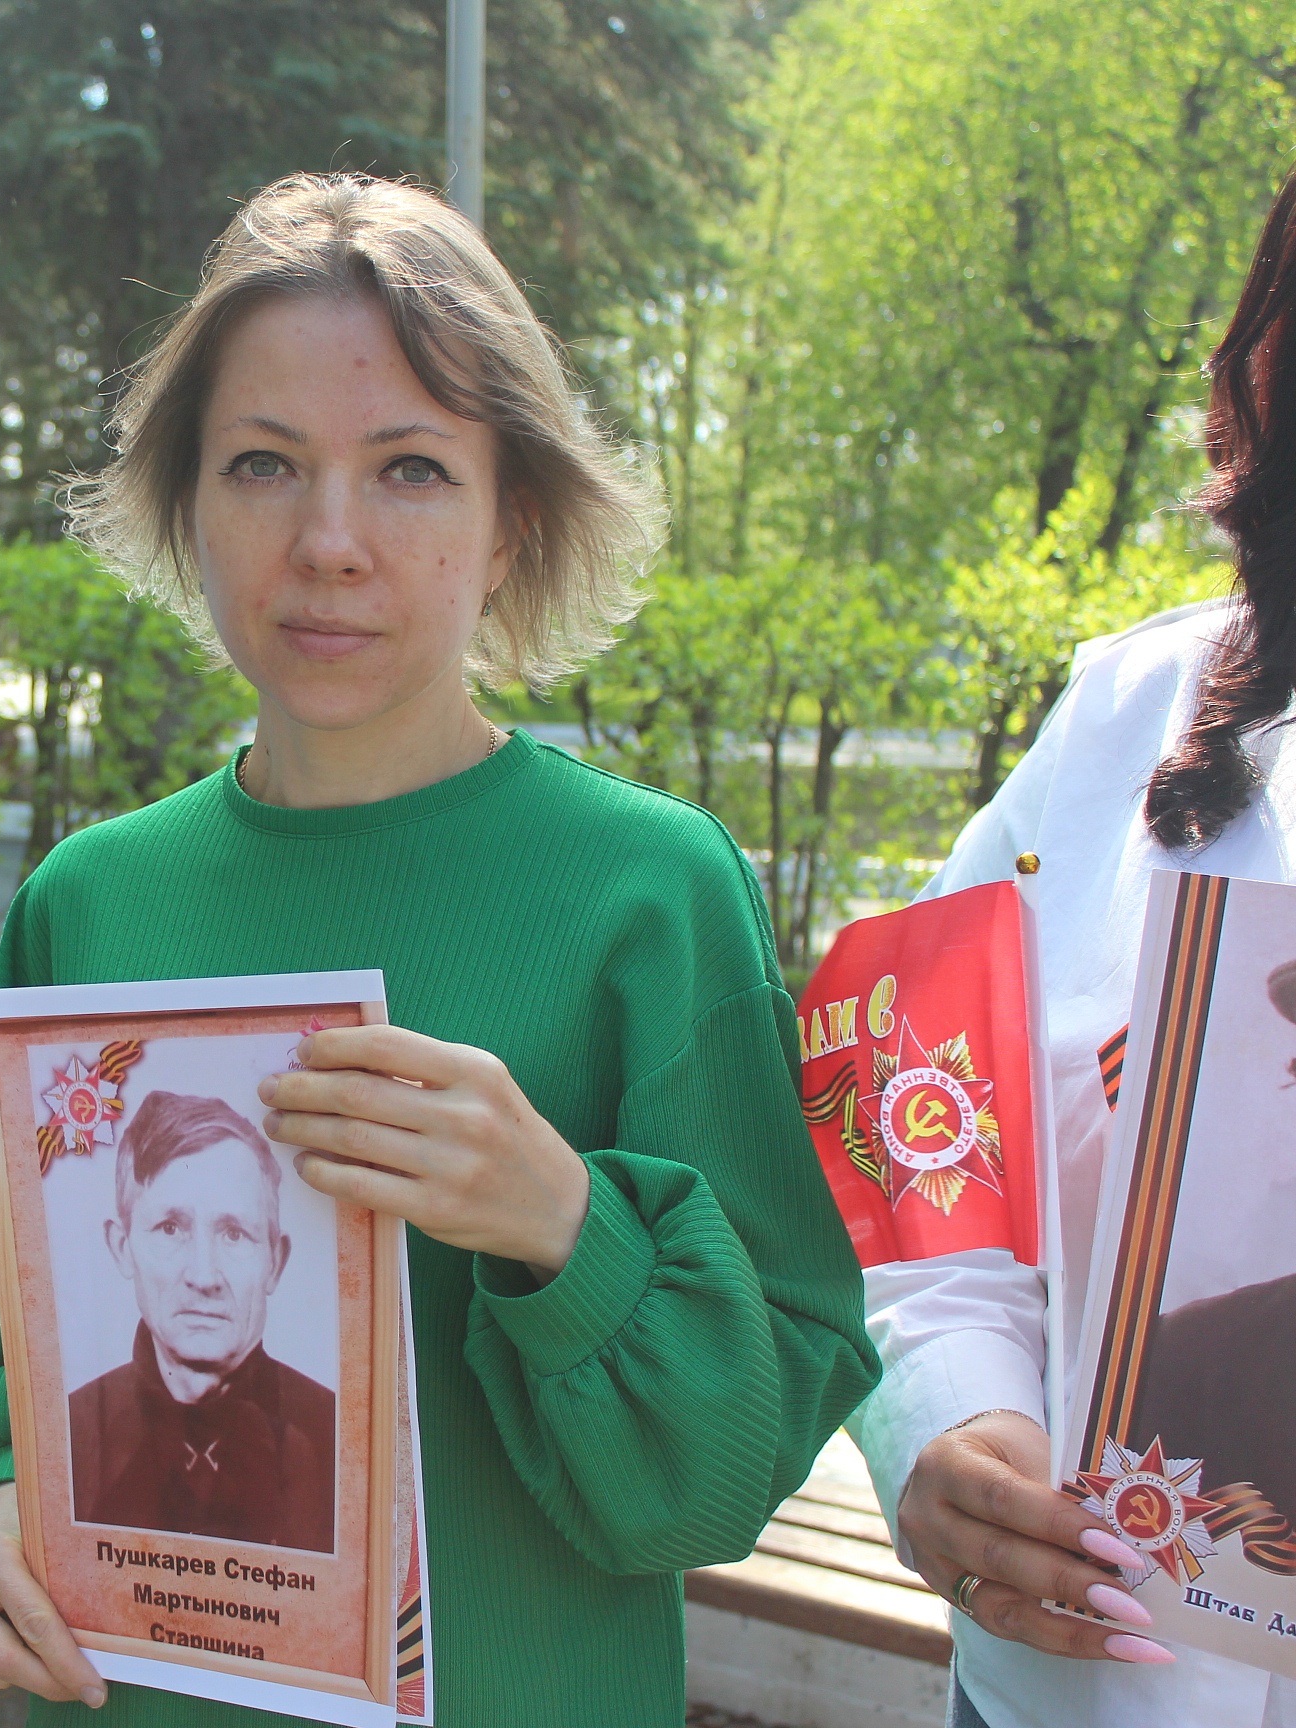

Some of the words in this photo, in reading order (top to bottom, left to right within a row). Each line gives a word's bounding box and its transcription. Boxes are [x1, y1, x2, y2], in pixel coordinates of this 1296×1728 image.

[1107, 1475, 1179, 1535] ОТЕЧЕСТВЕННАЯ
[96, 1540, 216, 1577] Пушкарев
[224, 1558, 316, 1591] Стефан
[133, 1582, 280, 1626] Мартынович
[1183, 1586, 1256, 1622] Штаб
[150, 1623, 265, 1661] Старшина
